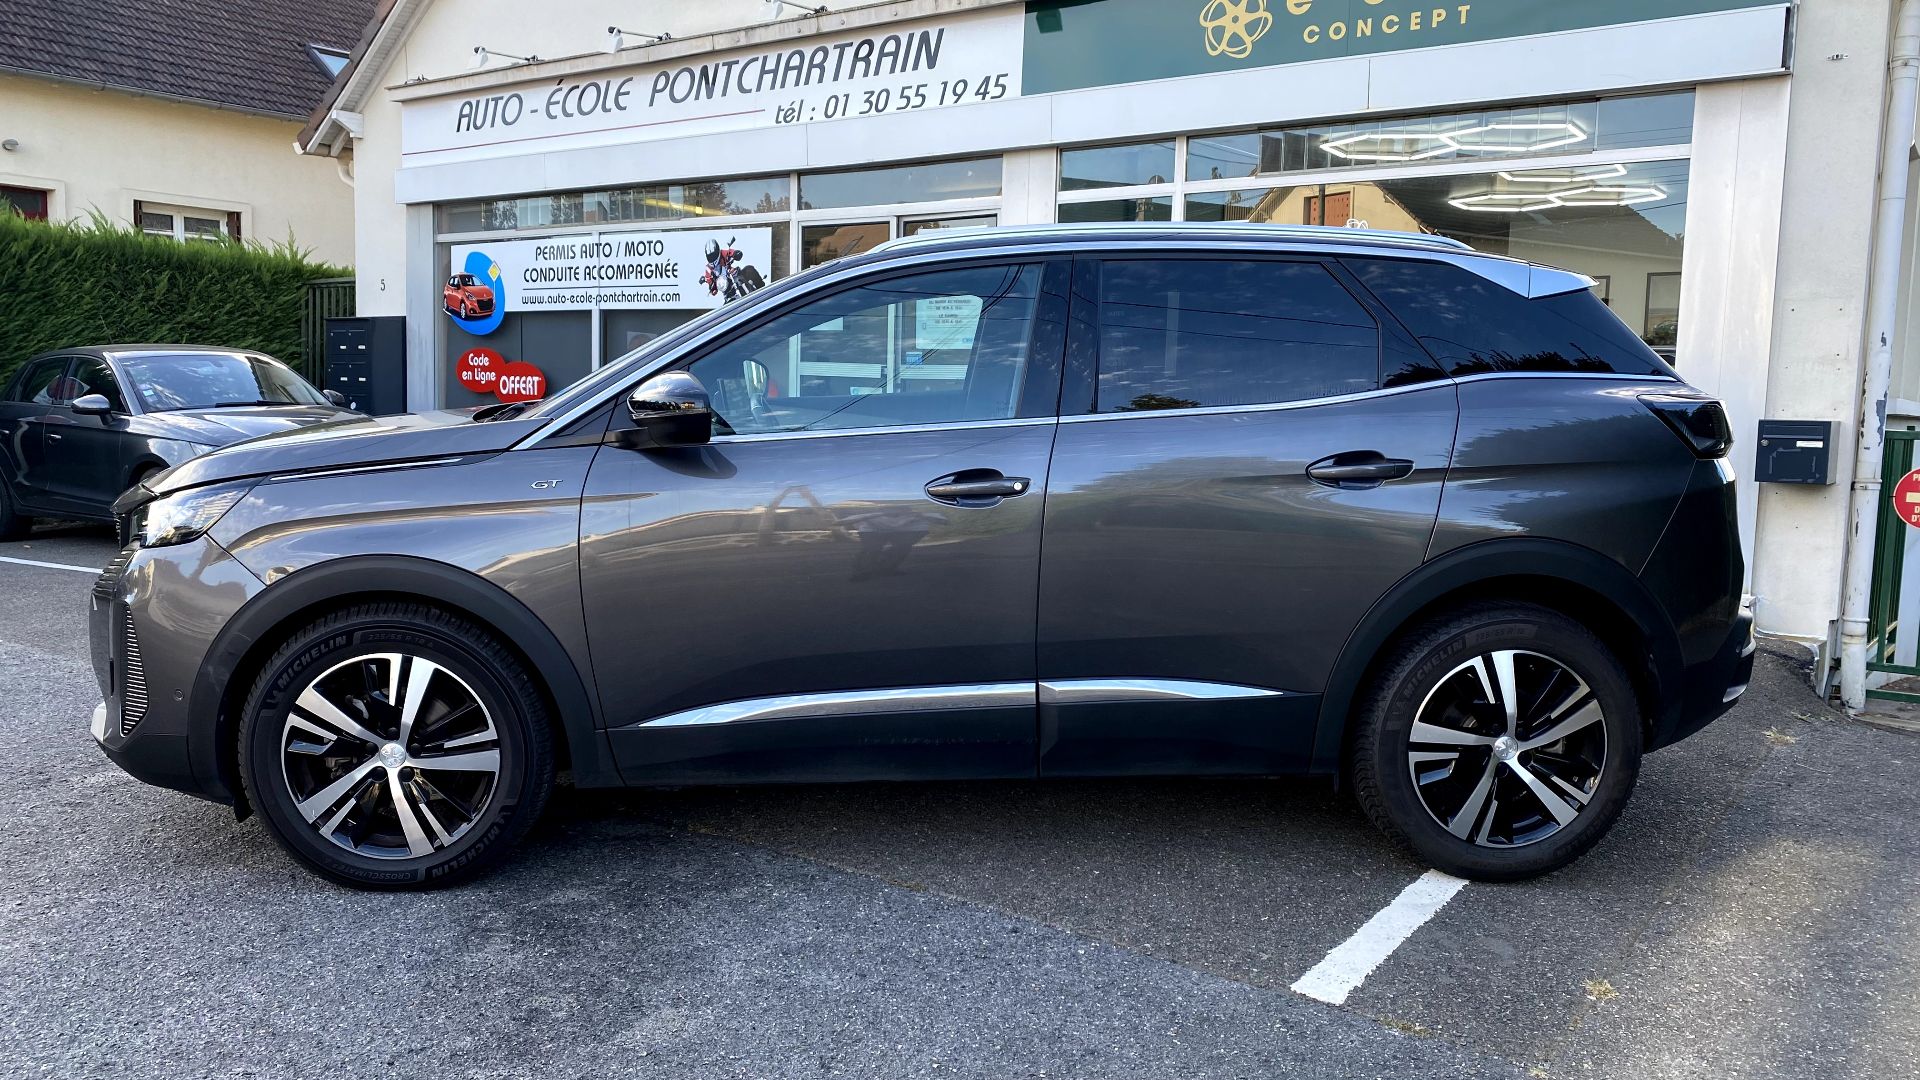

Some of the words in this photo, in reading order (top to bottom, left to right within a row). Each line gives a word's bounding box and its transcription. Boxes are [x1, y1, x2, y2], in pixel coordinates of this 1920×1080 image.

[1303, 5, 1471, 44] CONCEPT
[456, 93, 524, 133] AUTO
[545, 78, 634, 120] ÉCOLE
[649, 28, 945, 107] PONTCHARTRAIN
[823, 94, 849, 119] 01
[859, 88, 889, 115] 30
[896, 84, 928, 111] 55
[938, 79, 968, 106] 19
[974, 73, 1009, 101] 45
[535, 244, 576, 261] PERMIS
[580, 243, 612, 259] AUTO
[625, 240, 664, 257] MOTO
[523, 266, 580, 283] CONDUITE
[584, 259, 678, 281] ACCOMPAGNÉE
[380, 278, 386, 291] 5
[521, 291, 681, 306] www.auto-ecole-pontchartrain.com
[468, 353, 490, 366] Code
[462, 371, 472, 380] en
[474, 368, 496, 384] Ligne
[531, 479, 563, 489] GT
[277, 635, 346, 689] MICHELIN
[432, 825, 500, 878] MICHELIN
